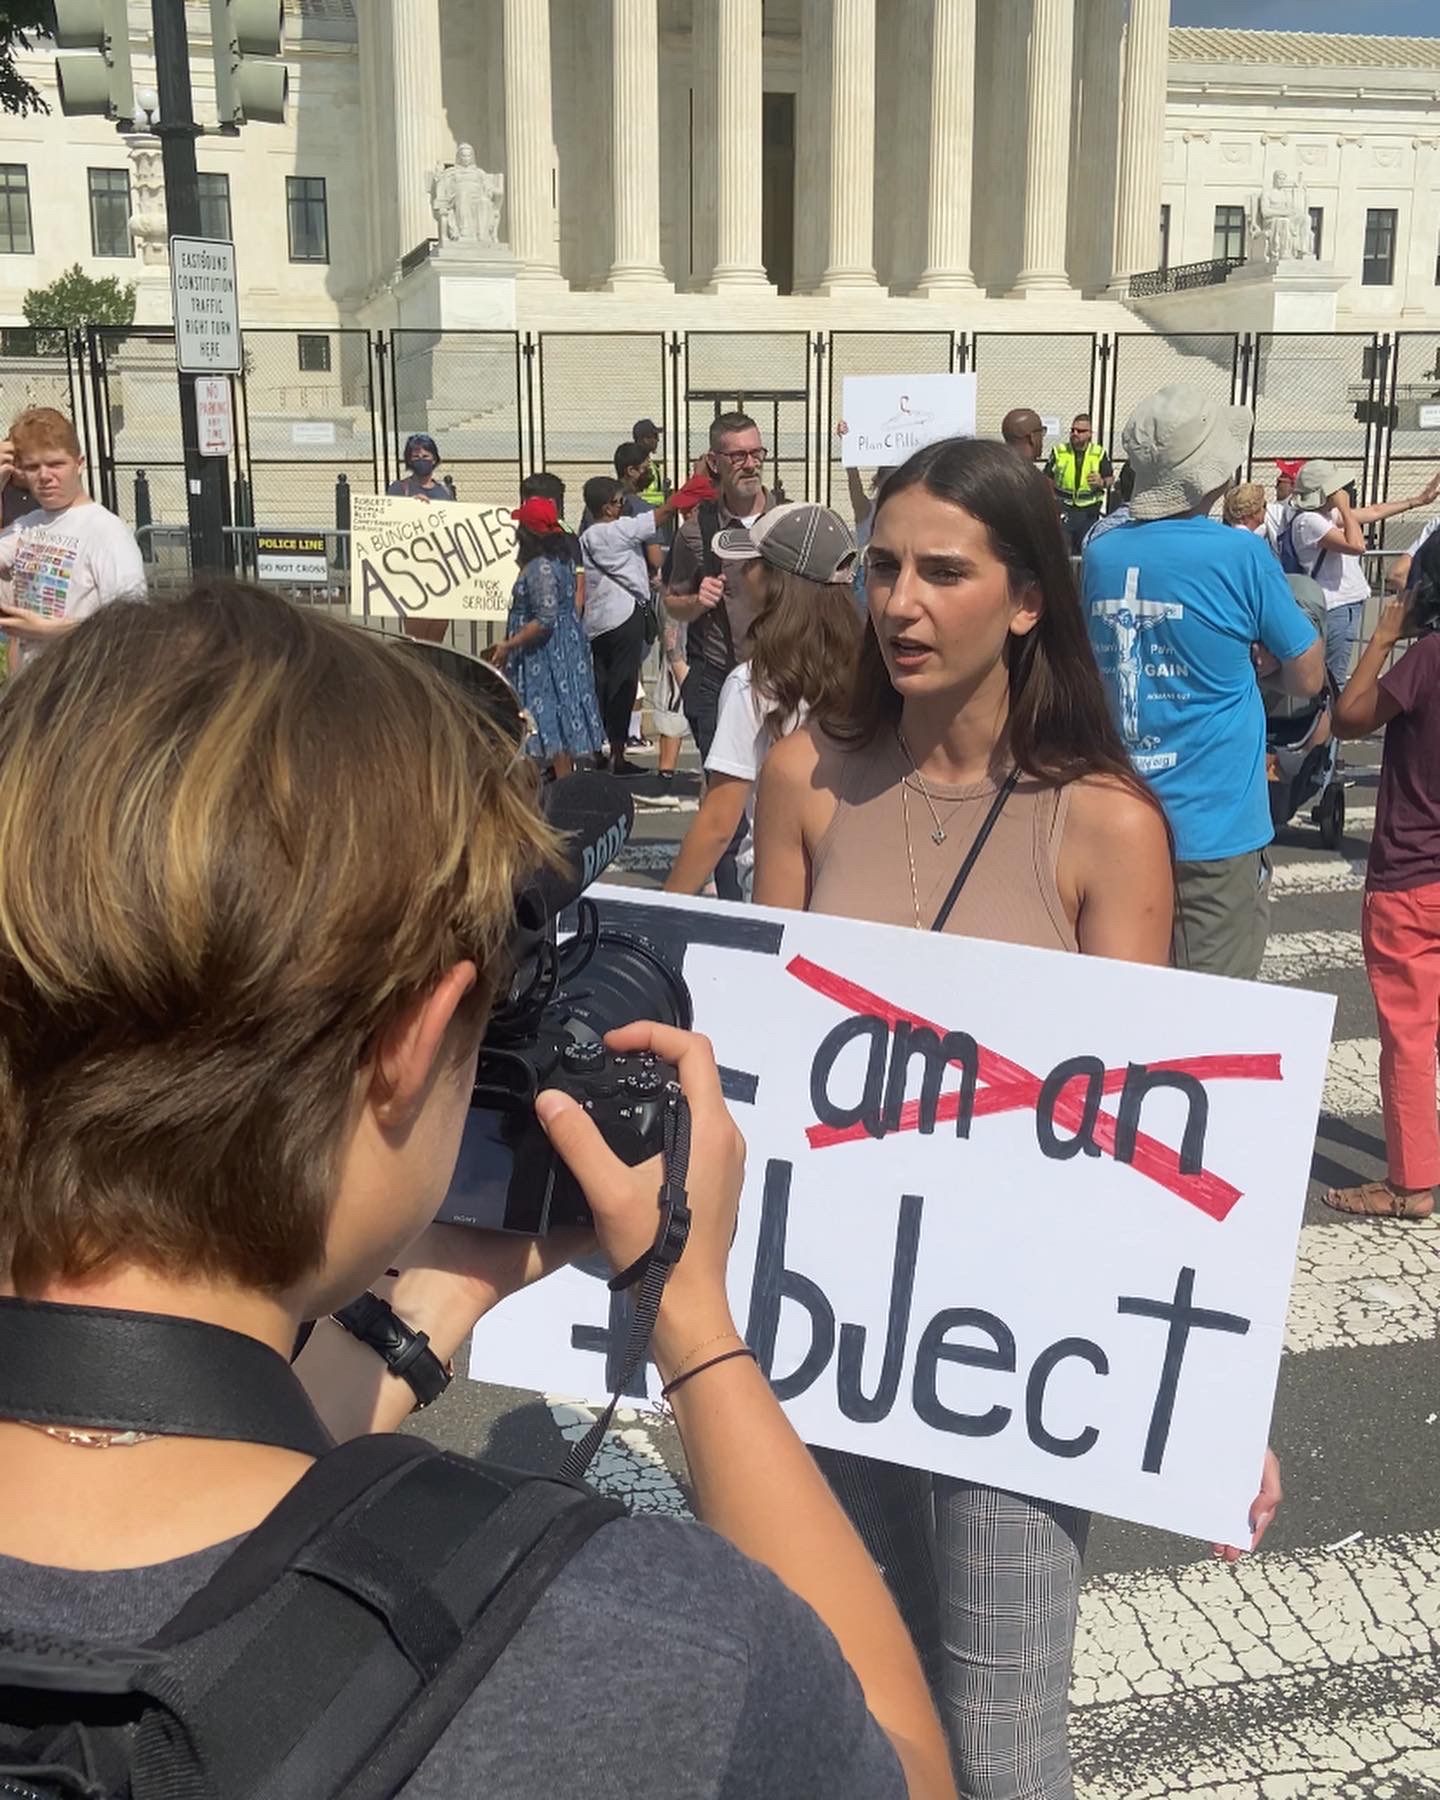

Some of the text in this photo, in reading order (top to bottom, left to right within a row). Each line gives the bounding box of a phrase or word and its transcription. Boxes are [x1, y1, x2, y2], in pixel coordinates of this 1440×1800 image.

[182, 253, 228, 271] EASTBOUND
[178, 274, 233, 293] CONSTITUTION
[191, 297, 224, 314] TRAFFIC
[185, 319, 232, 335] RIGHT TURN
[200, 342, 220, 357] HERE
[858, 436, 883, 451] Plan
[884, 434, 894, 448] C
[355, 509, 448, 559] A BUNCH OF
[258, 538, 325, 551] POLICE LINE
[260, 562, 327, 574] DO NOT CROSS
[361, 507, 518, 618] ASSHOLES
[1144, 663, 1190, 678] GAIN
[809, 1012, 979, 1140] am
[1035, 1053, 1209, 1175] an
